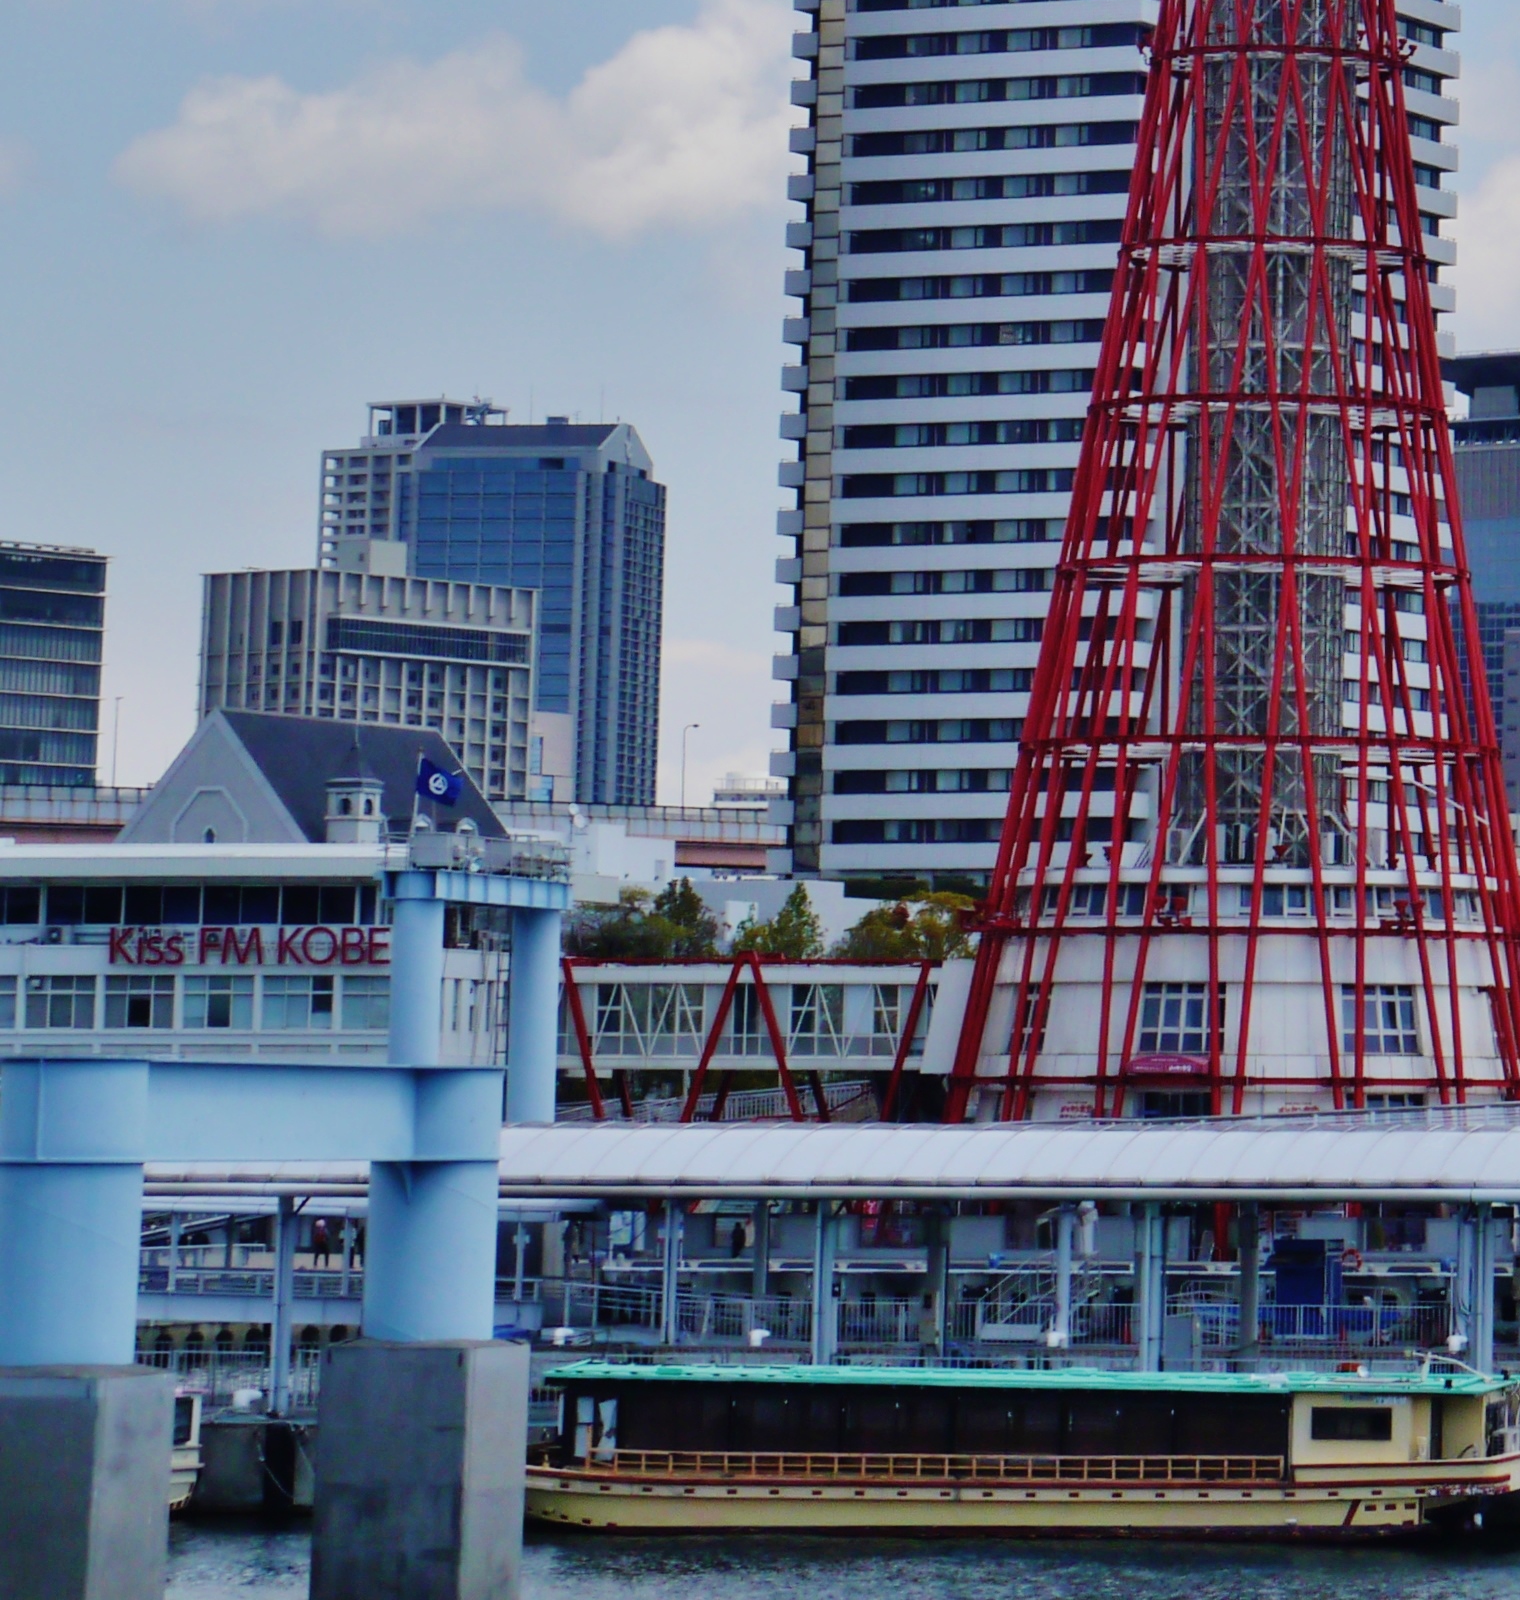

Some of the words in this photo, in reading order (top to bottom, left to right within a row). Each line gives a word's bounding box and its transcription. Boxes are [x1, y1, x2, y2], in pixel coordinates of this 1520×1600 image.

[108, 926, 184, 965] Kiss
[199, 926, 263, 965] FM
[277, 926, 391, 965] KOBE
